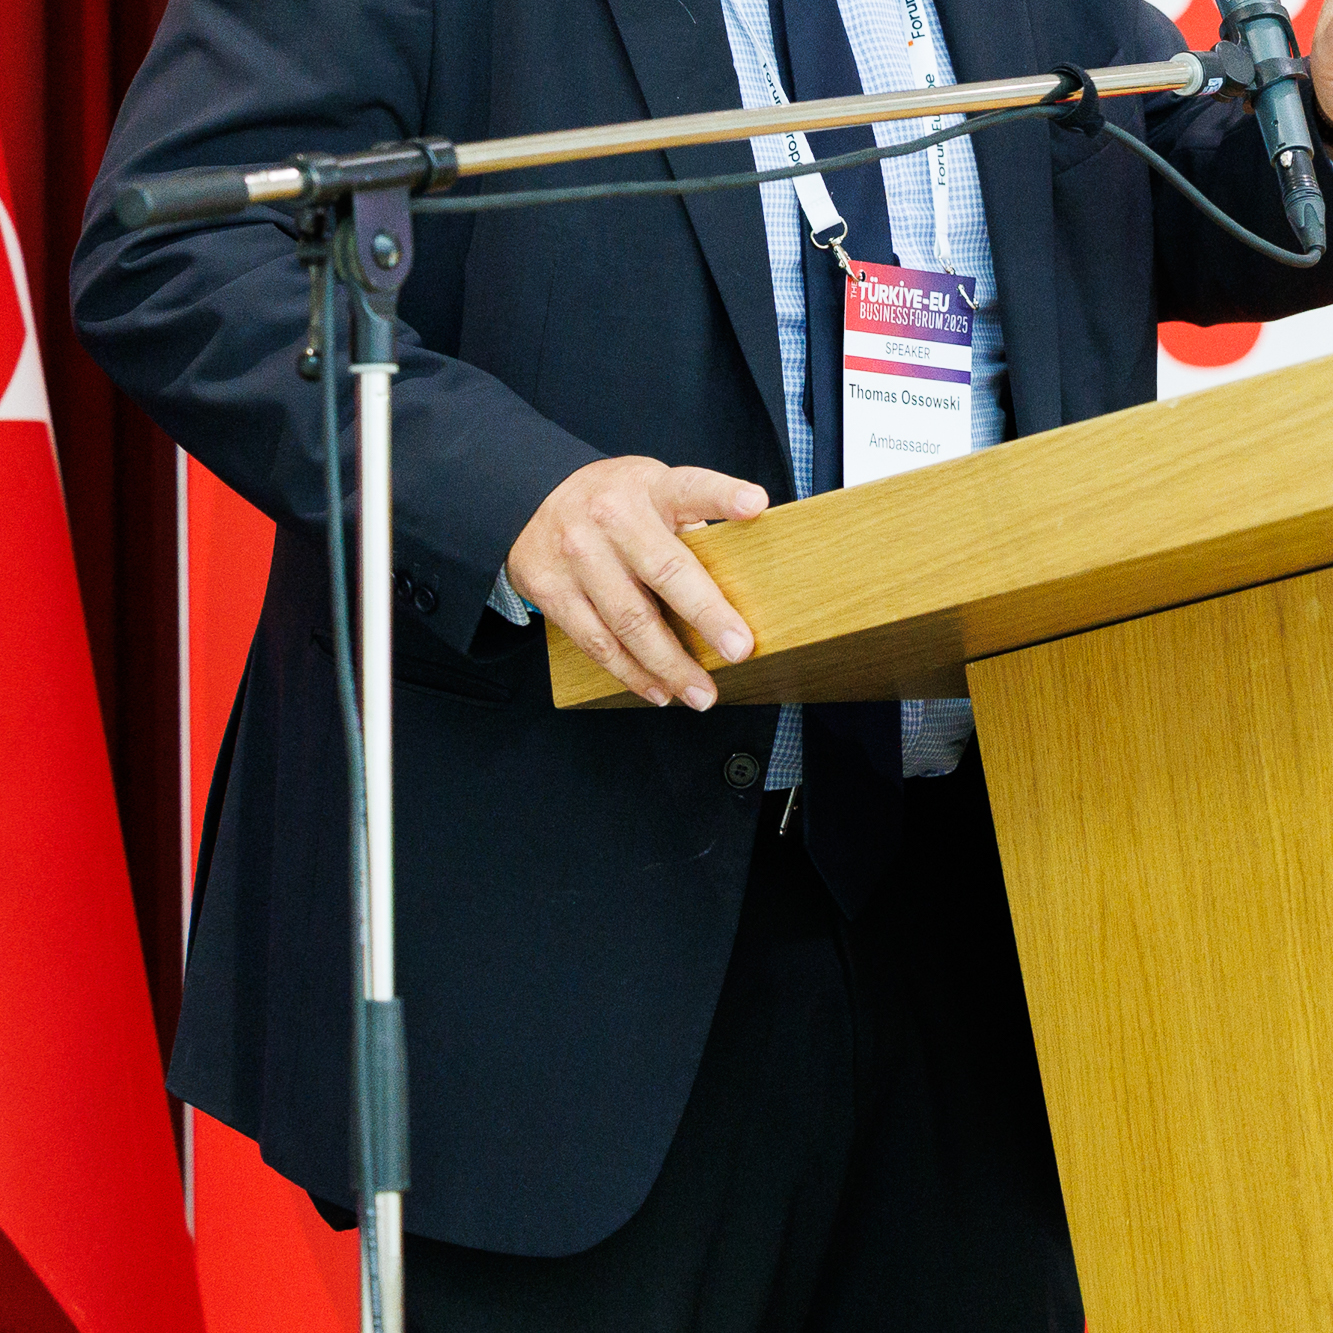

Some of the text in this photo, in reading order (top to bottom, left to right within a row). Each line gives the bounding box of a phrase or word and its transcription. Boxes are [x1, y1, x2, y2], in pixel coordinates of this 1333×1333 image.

[858, 275, 951, 313] TÜRKİYE-EU
[860, 302, 969, 334] BUSINESS FORUM 2025
[885, 342, 931, 360] SPEAKER
[849, 383, 960, 411] Thomas Ossowski
[869, 432, 941, 455] Ambassador
